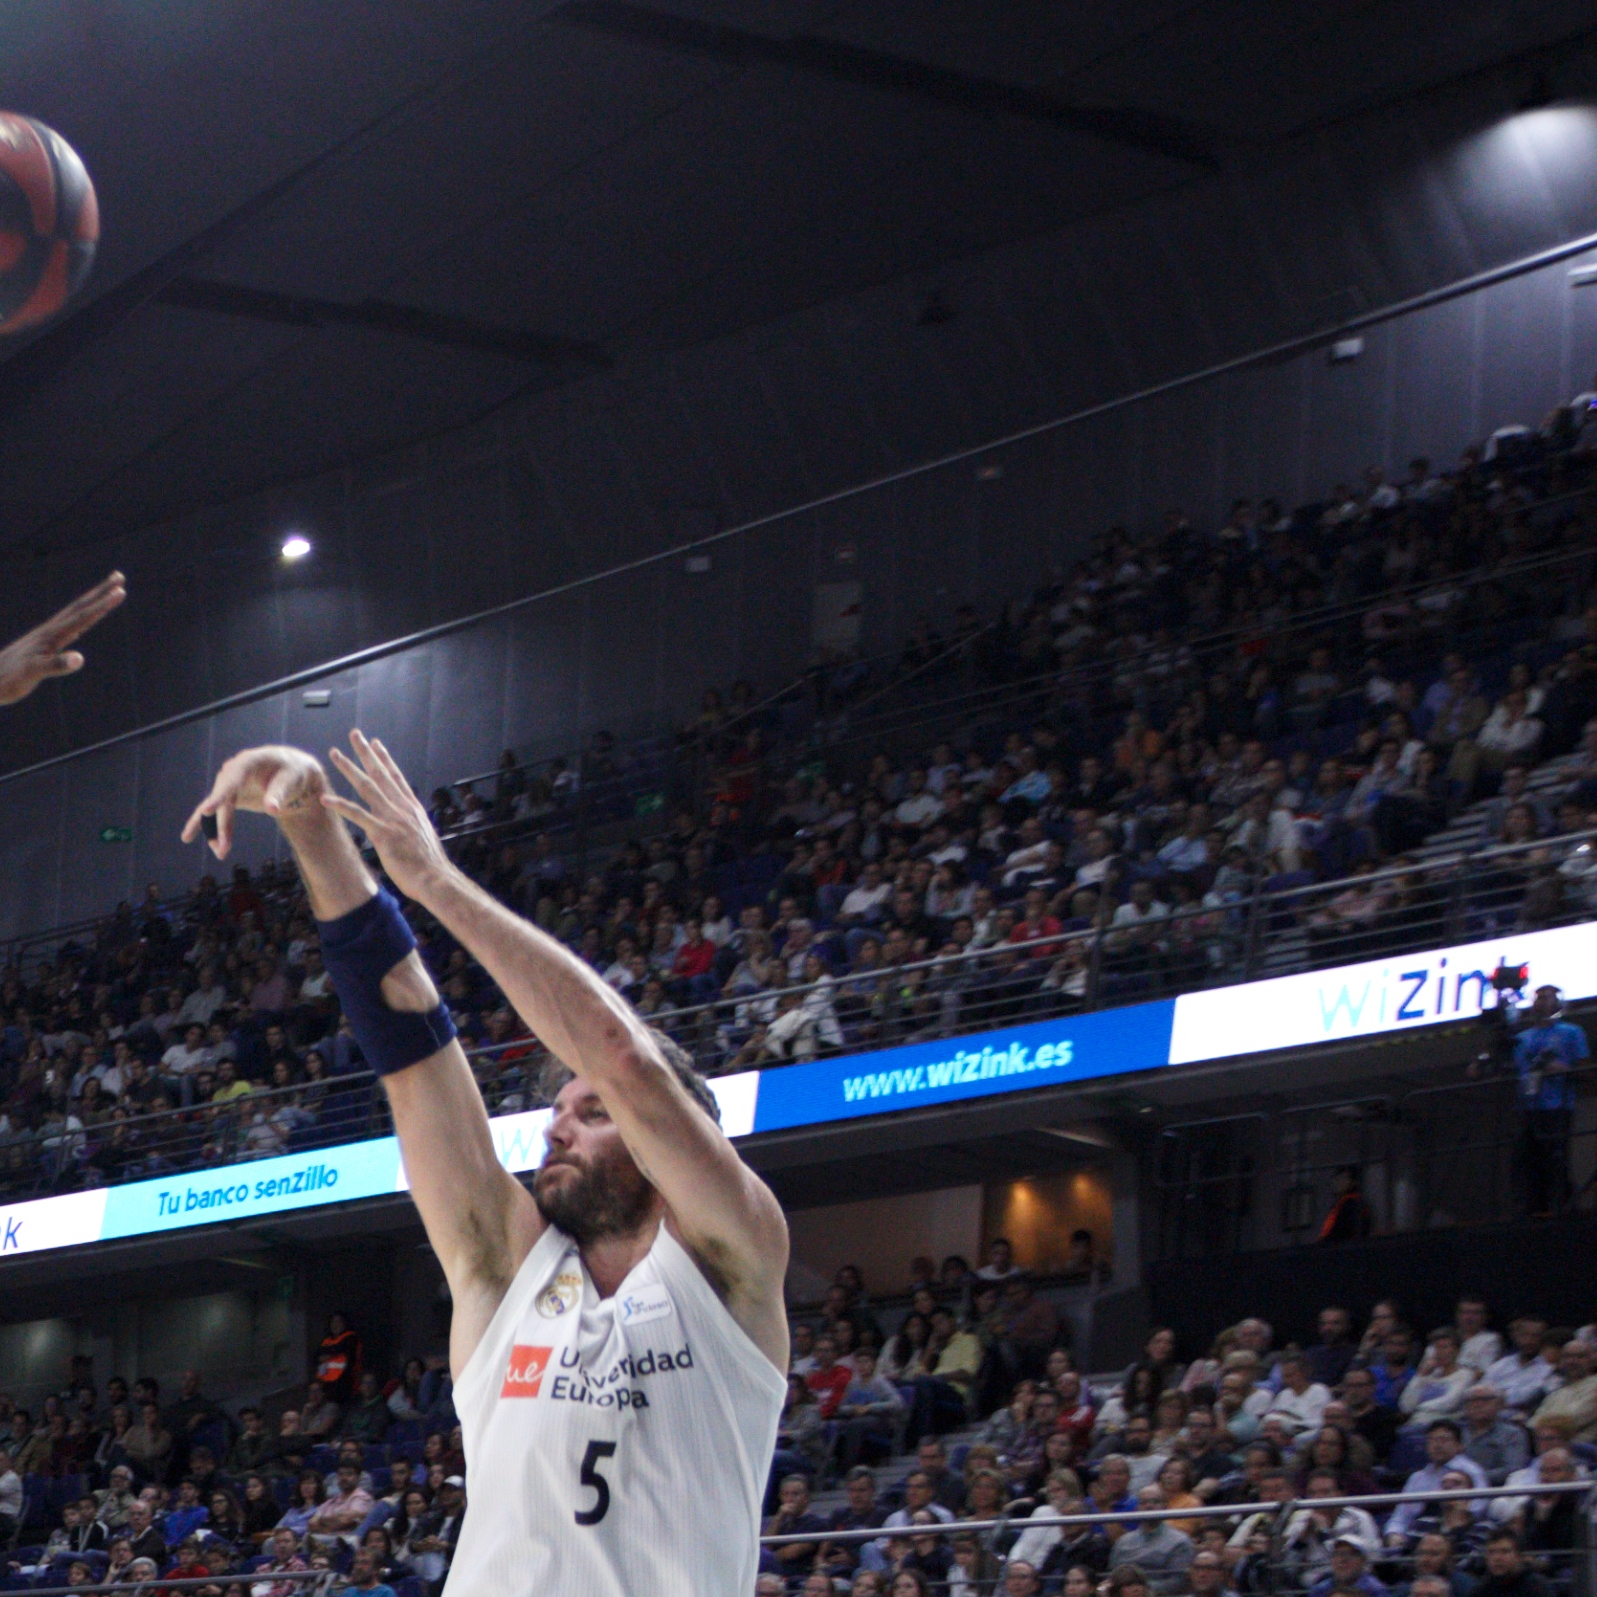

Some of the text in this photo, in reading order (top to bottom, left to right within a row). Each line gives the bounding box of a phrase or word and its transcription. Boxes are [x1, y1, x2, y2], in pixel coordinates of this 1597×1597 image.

[159, 1192, 181, 1216] Tu
[184, 1184, 249, 1212] banco
[573, 1439, 617, 1526] 5
